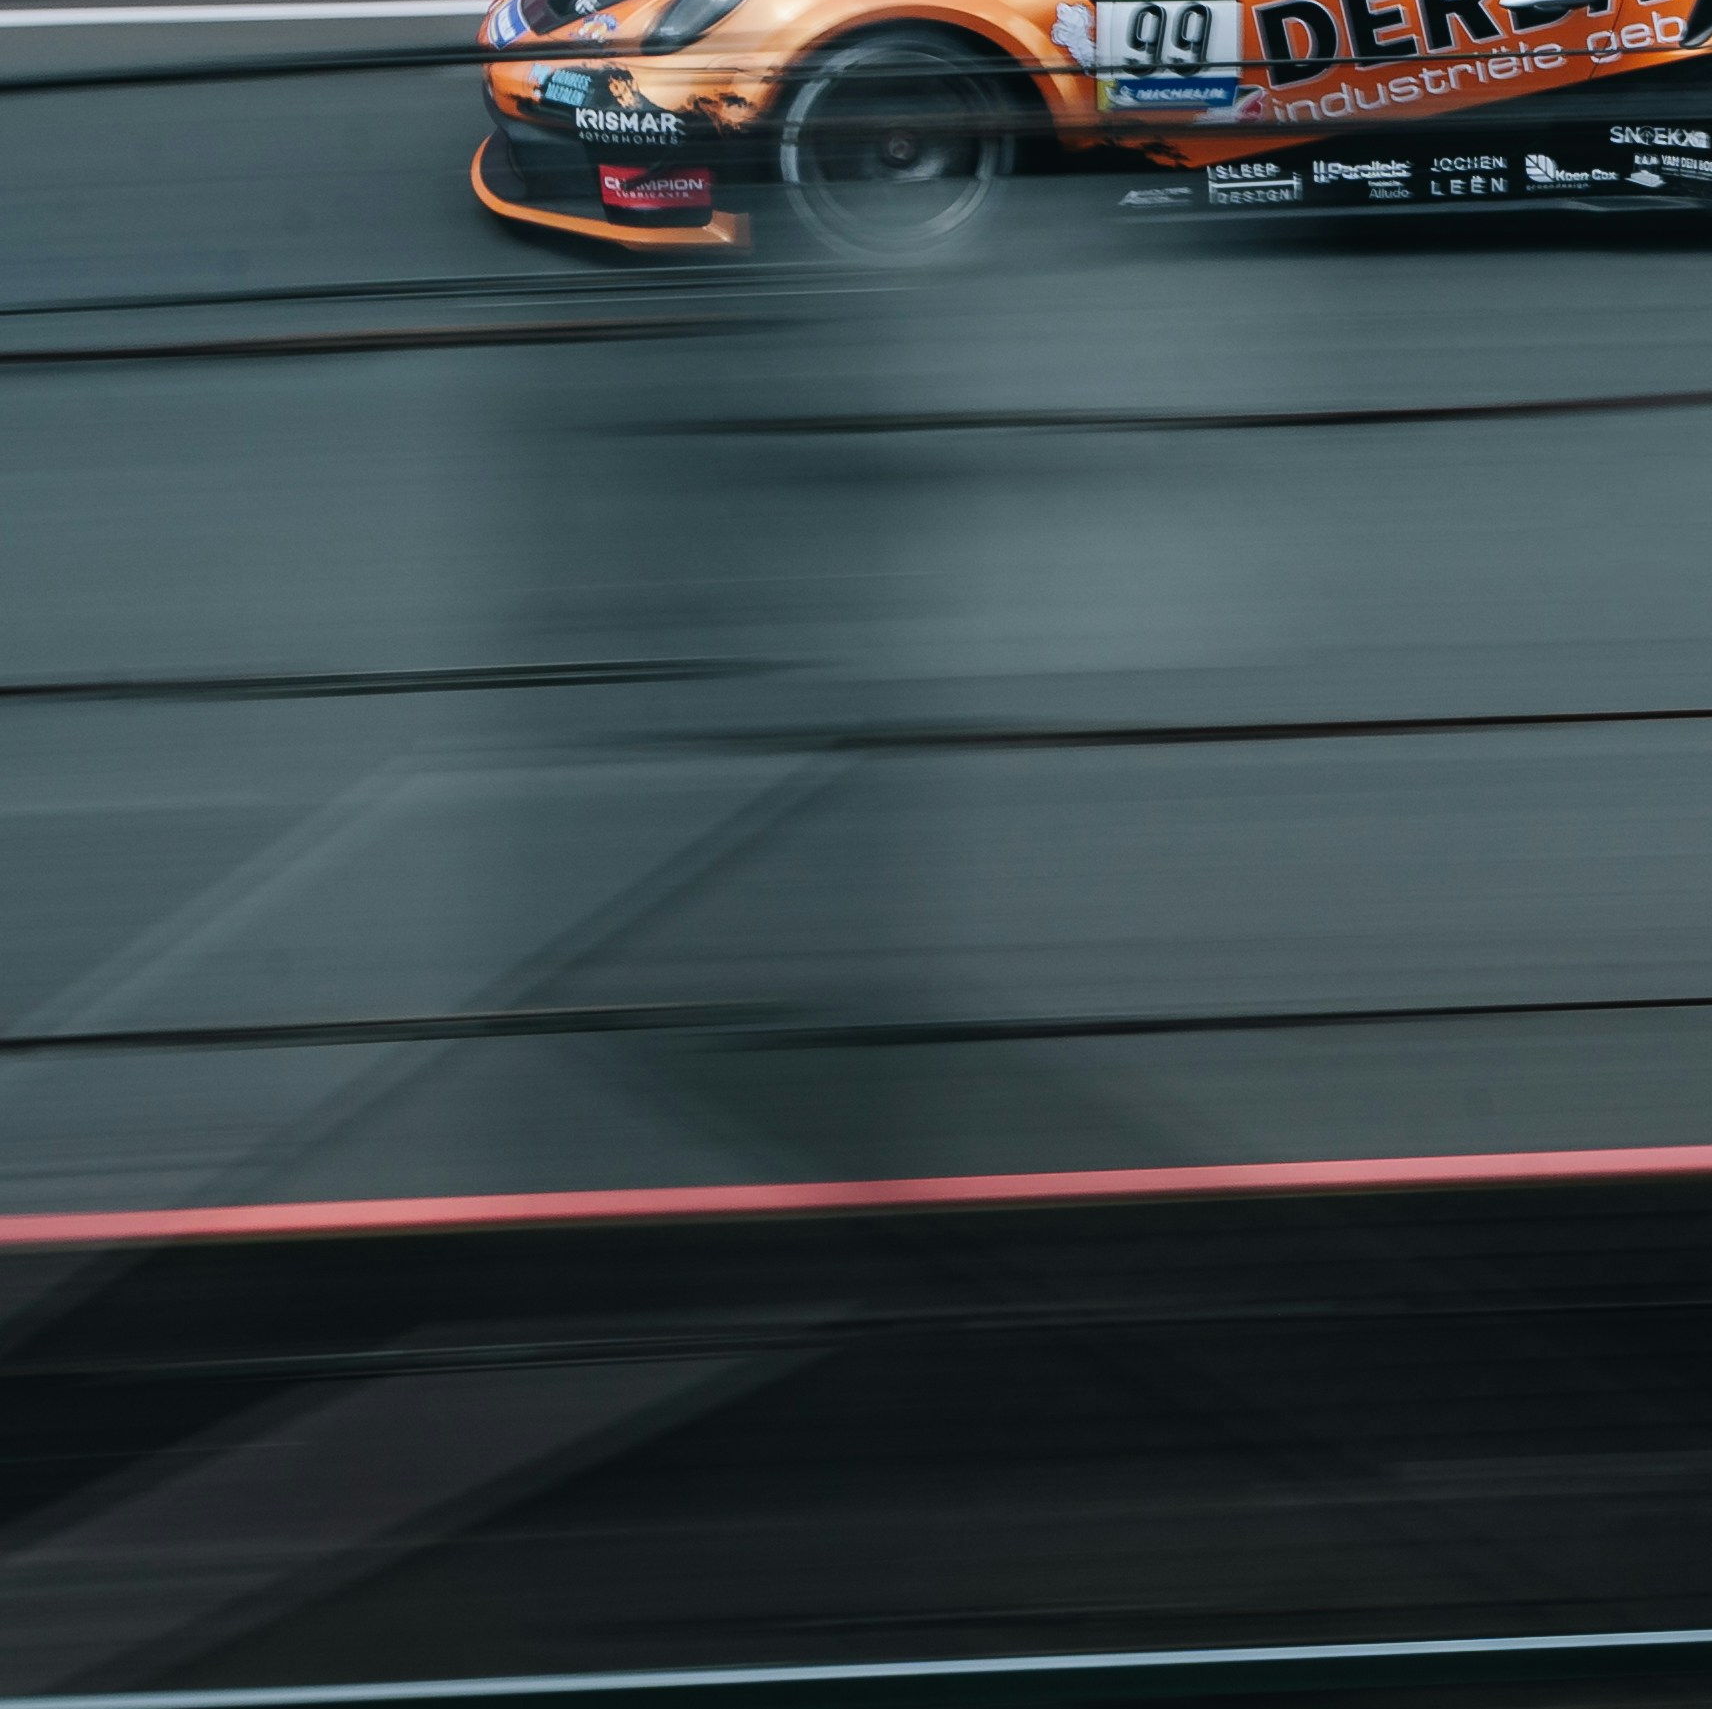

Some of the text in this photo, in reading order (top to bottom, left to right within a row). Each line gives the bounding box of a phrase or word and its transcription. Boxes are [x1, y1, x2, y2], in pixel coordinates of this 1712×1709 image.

[1123, 2, 1212, 76] 99
[1273, 38, 1564, 124] industriële
[576, 108, 681, 132] KRISMAR
[1215, 163, 1280, 179] SLEEP
[1431, 156, 1508, 171] JOCHEN
[1592, 168, 1619, 180] Cox
[1431, 176, 1508, 194] LEËN
[1217, 188, 1292, 204] DESIGN
